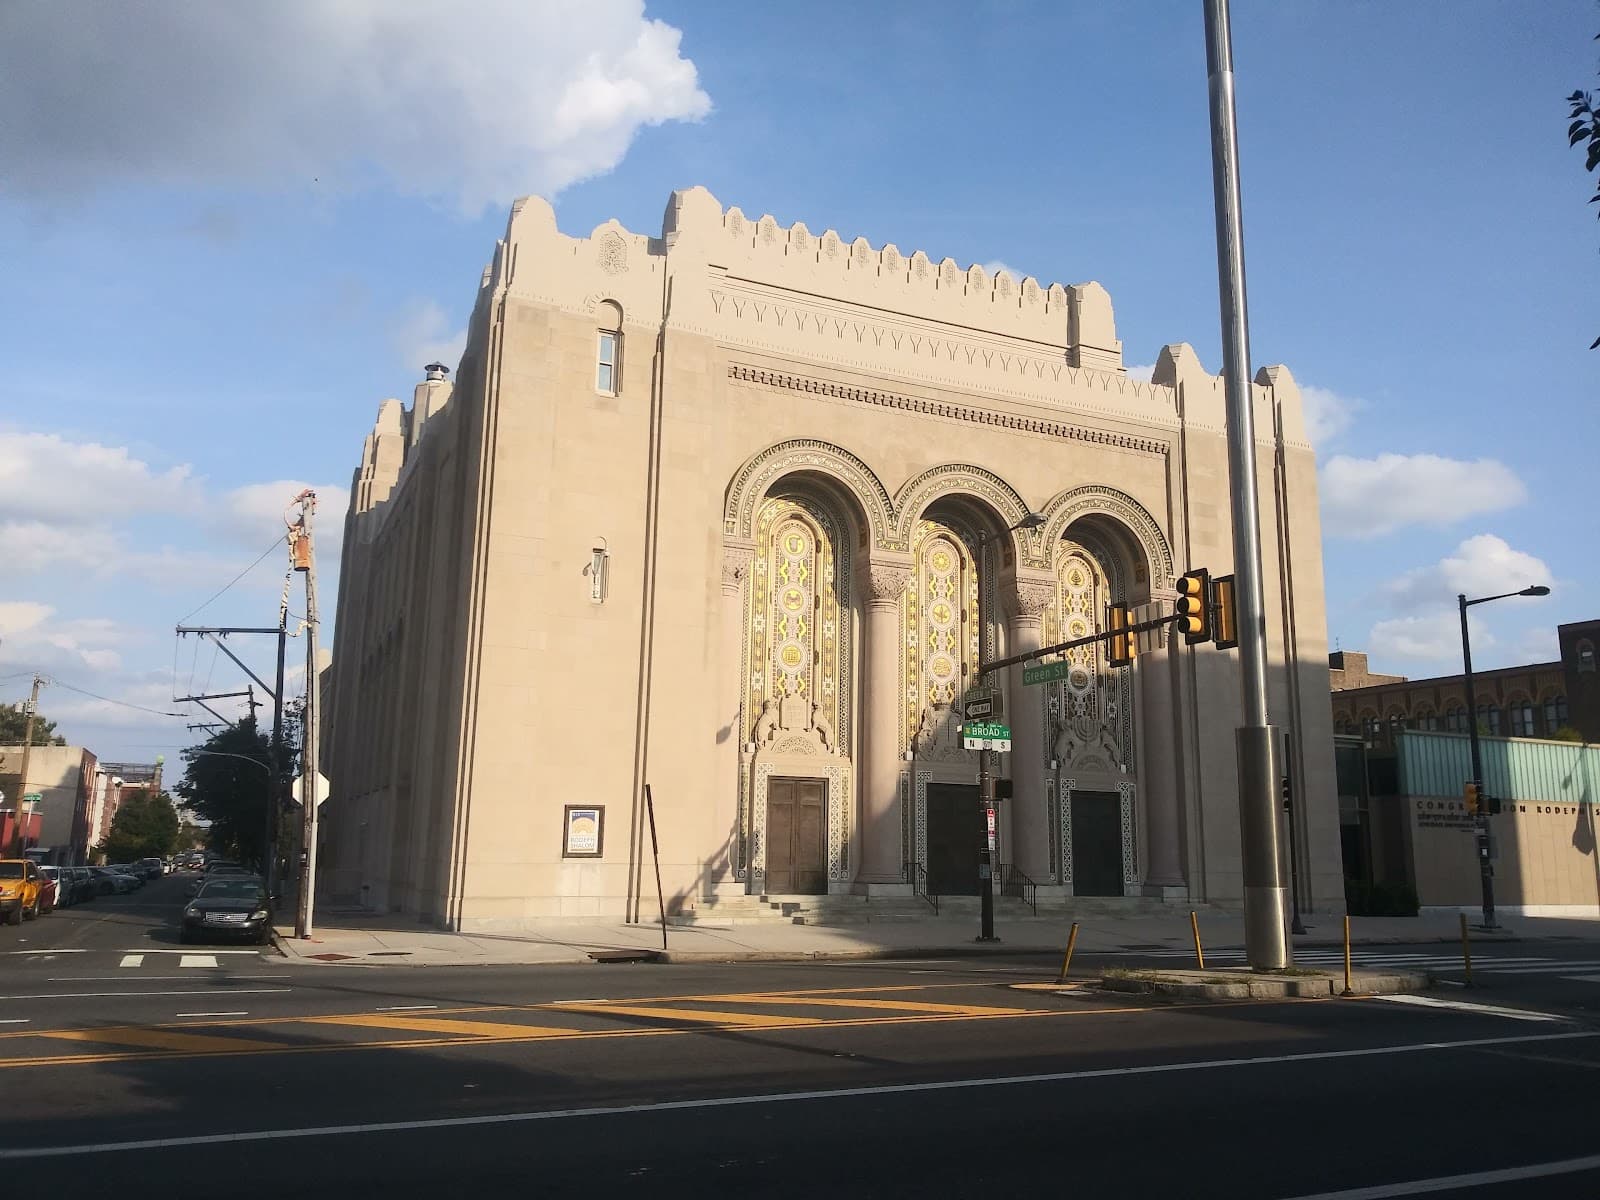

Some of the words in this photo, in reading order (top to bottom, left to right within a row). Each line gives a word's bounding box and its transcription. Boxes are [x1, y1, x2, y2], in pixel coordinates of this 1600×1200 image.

[1025, 669, 1050, 682] Green
[1055, 665, 1064, 677] St
[971, 705, 981, 713] ONE
[981, 703, 989, 711] WAY
[972, 727, 1000, 737] BROAD
[969, 739, 975, 748] N
[1000, 741, 1006, 749] S
[1417, 801, 1526, 813] CONGRION
[1537, 806, 1585, 815] RODEPH
